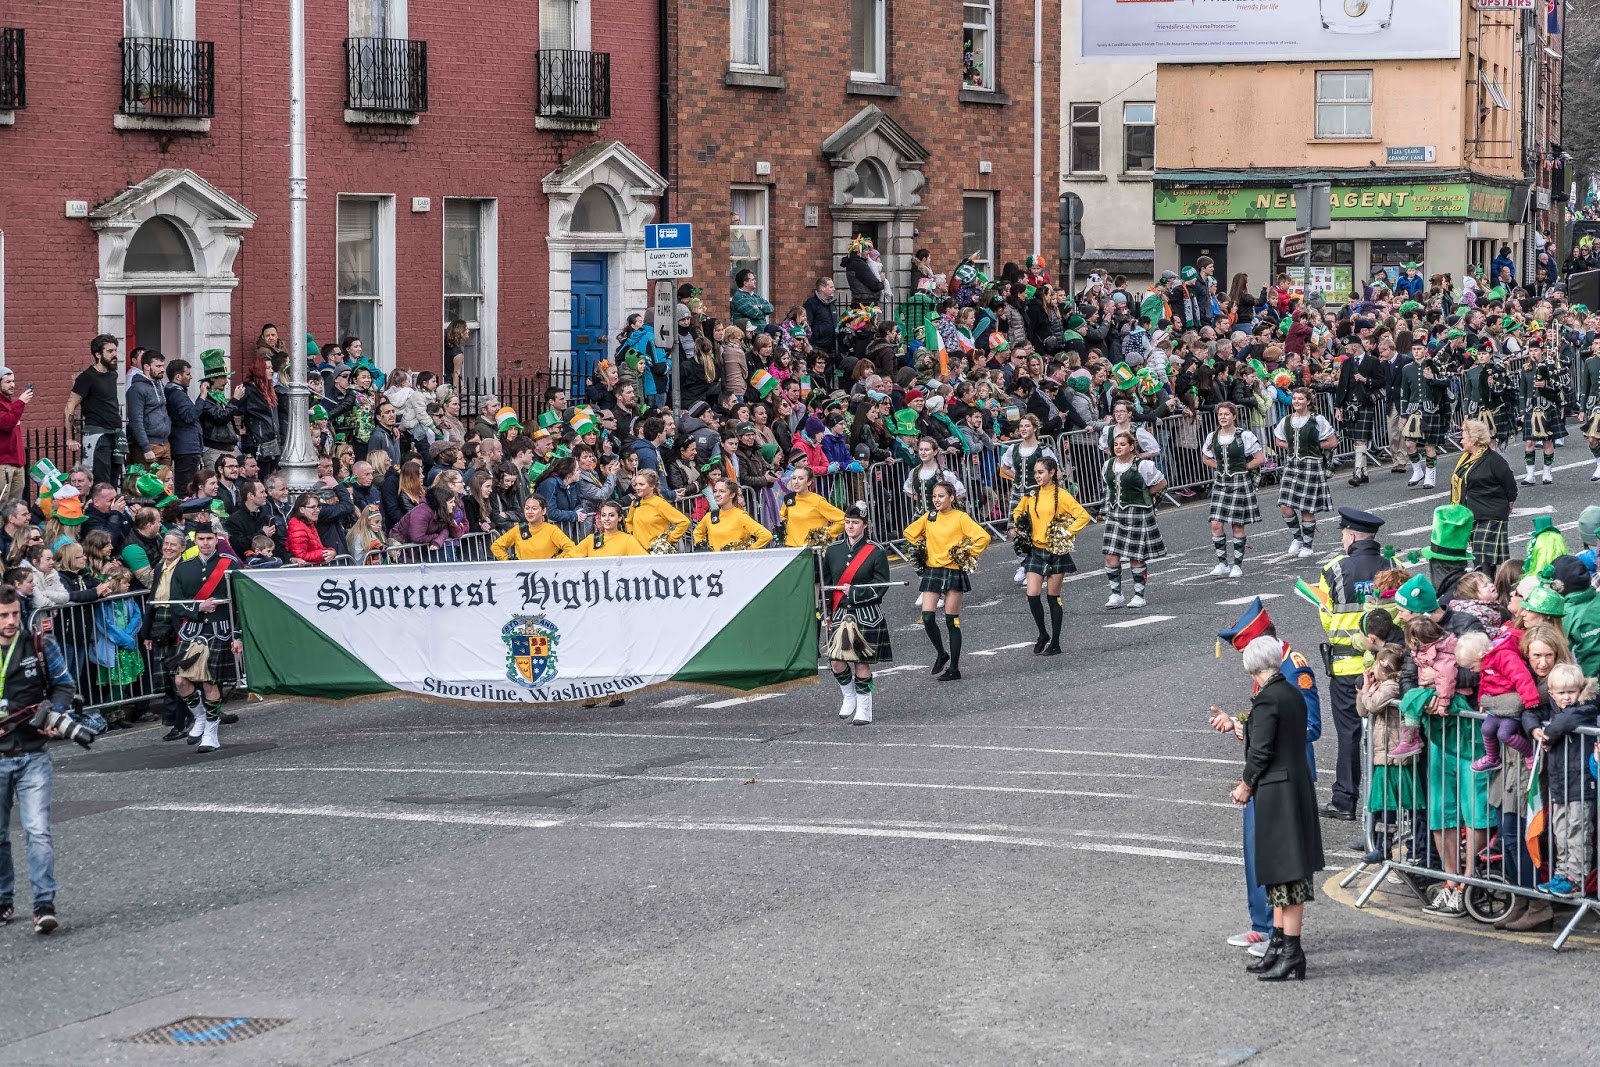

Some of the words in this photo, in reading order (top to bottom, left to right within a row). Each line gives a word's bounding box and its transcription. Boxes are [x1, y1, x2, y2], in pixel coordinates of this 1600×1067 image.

[1256, 192, 1409, 209] NEAGENT
[316, 577, 498, 616] Shorecrest
[515, 569, 724, 611] Highlanders
[24, 668, 37, 678] 04
[422, 676, 524, 703] Shoreline,
[528, 675, 645, 702] Washington
